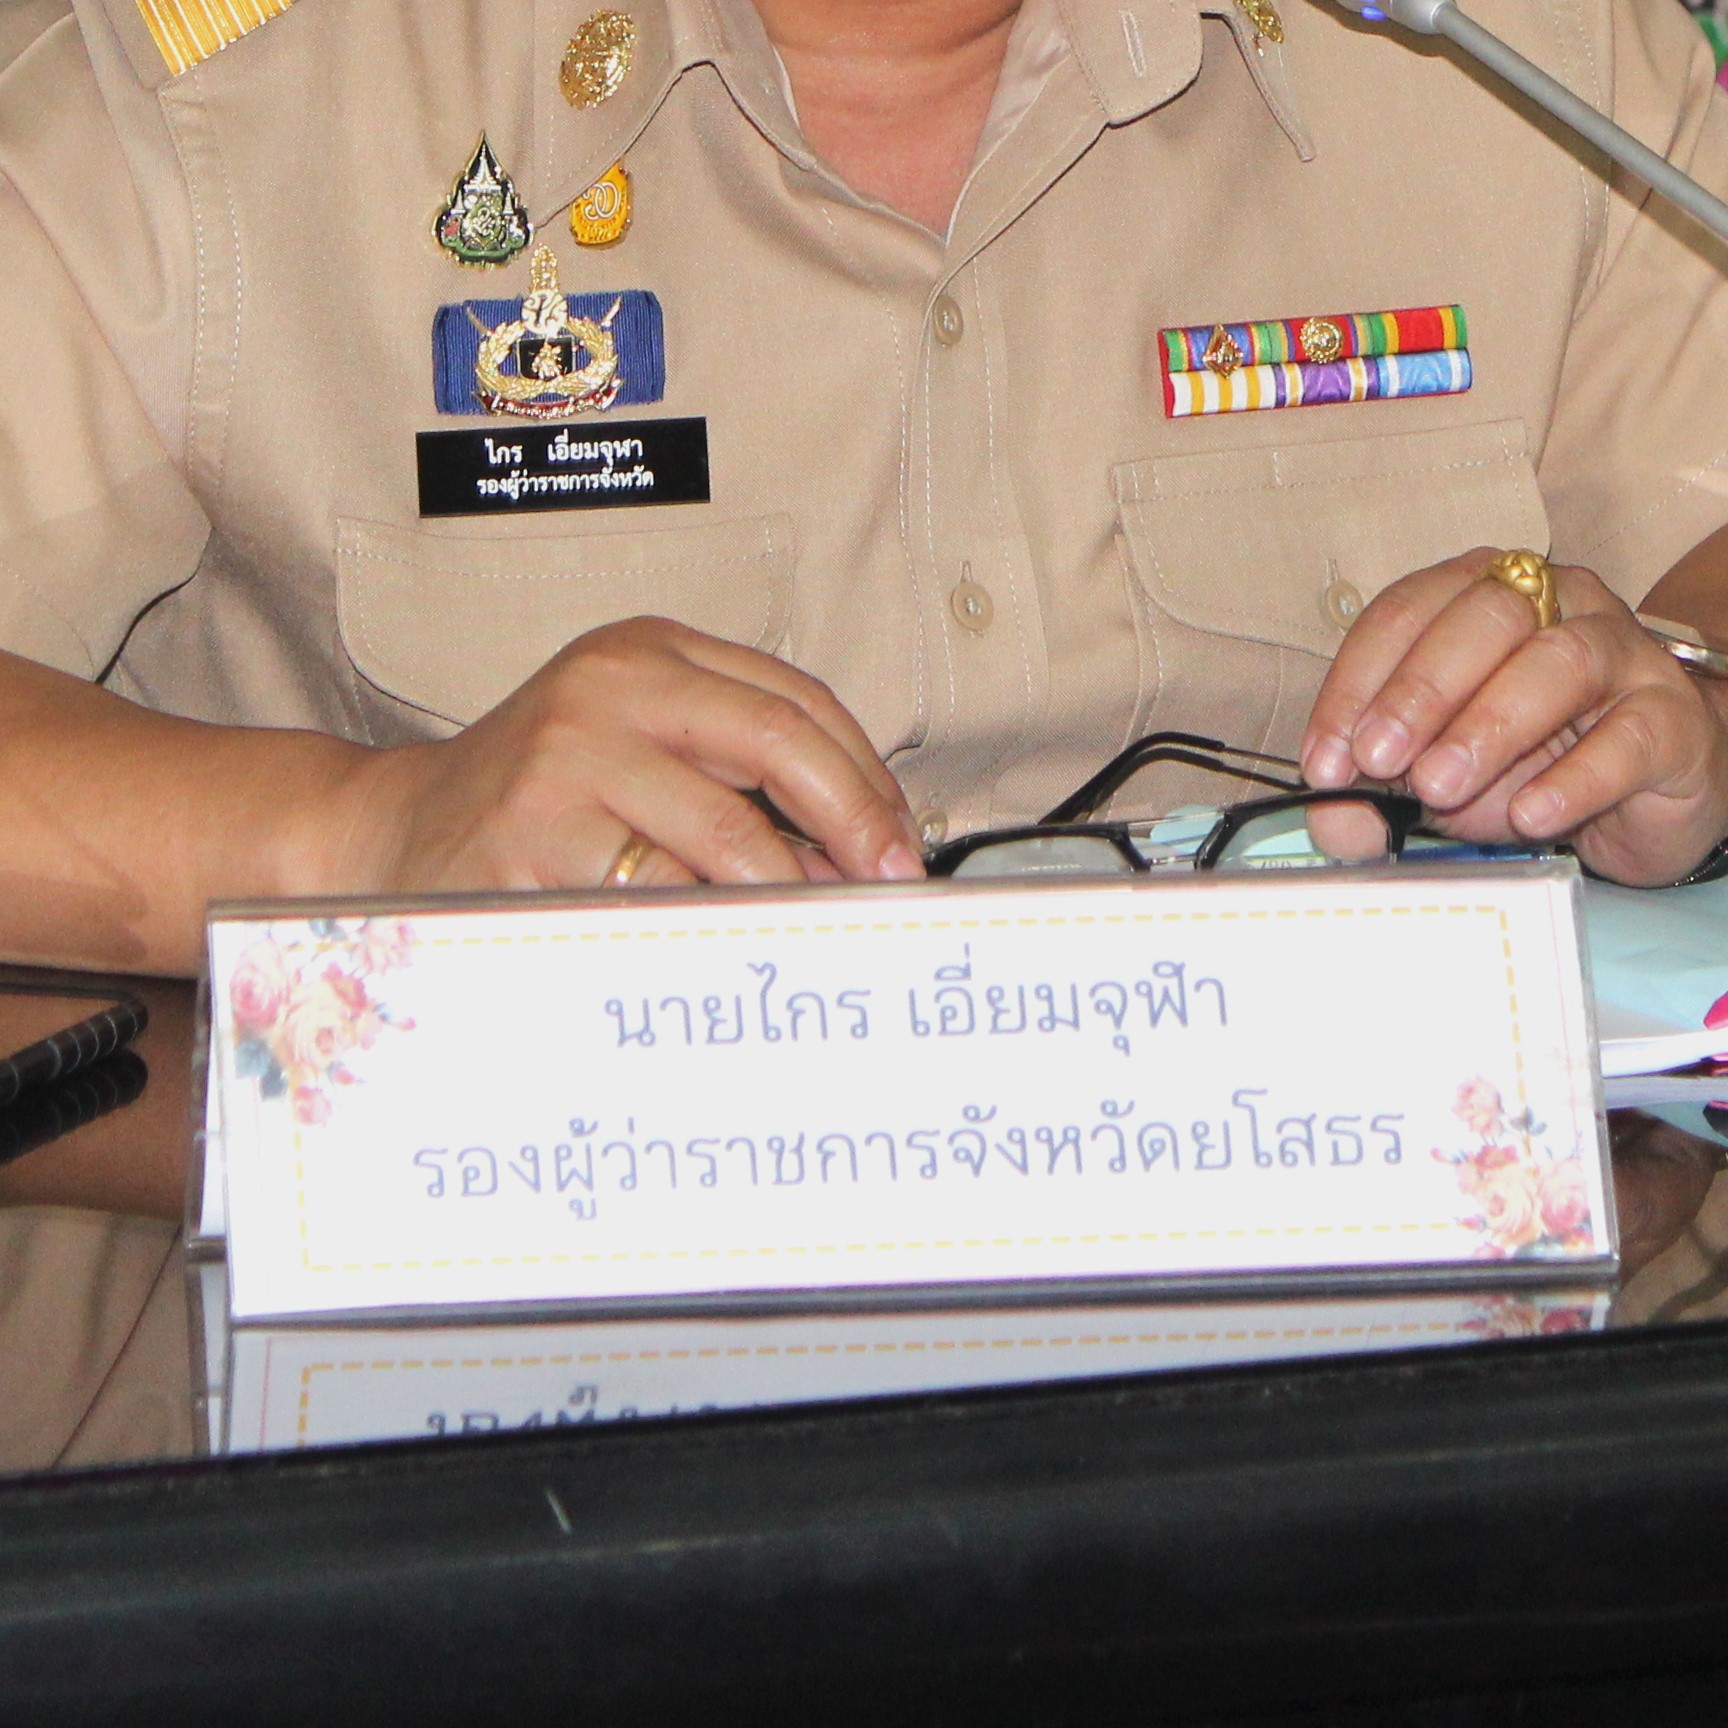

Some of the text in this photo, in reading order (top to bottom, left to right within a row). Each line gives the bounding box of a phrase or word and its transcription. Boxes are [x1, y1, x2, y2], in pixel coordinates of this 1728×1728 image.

[476, 466, 654, 500] รองผู้ว่าราชการจังหวัด
[484, 437, 523, 465] ไกร
[604, 942, 1228, 1057] นายไกร เอี่ยมจุฬา
[412, 1088, 1406, 1221] รองผู้ว่าราชการจังหวัดยโสธร
